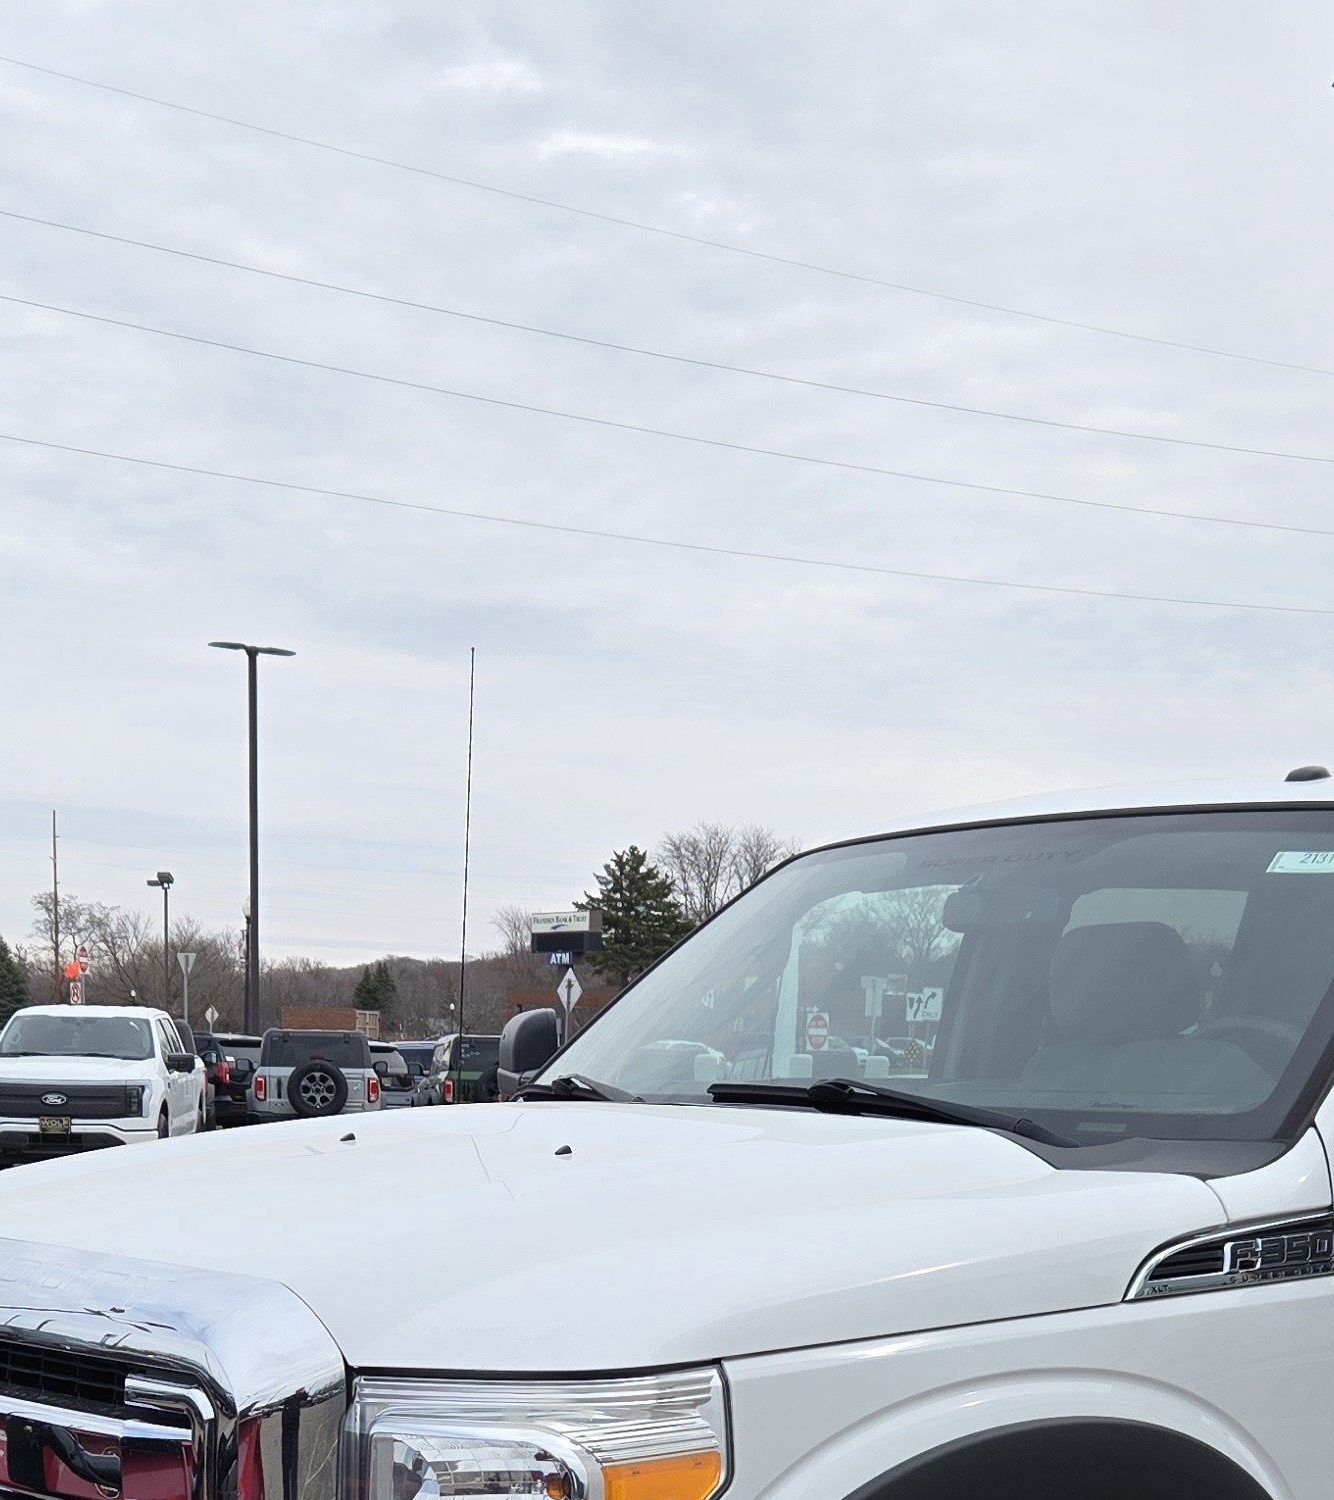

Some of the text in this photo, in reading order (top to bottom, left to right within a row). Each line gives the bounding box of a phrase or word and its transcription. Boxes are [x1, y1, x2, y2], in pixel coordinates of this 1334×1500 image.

[1003, 849, 1082, 863] DUTY
[550, 953, 569, 964] ATM
[1152, 1284, 1169, 1292] XLT
